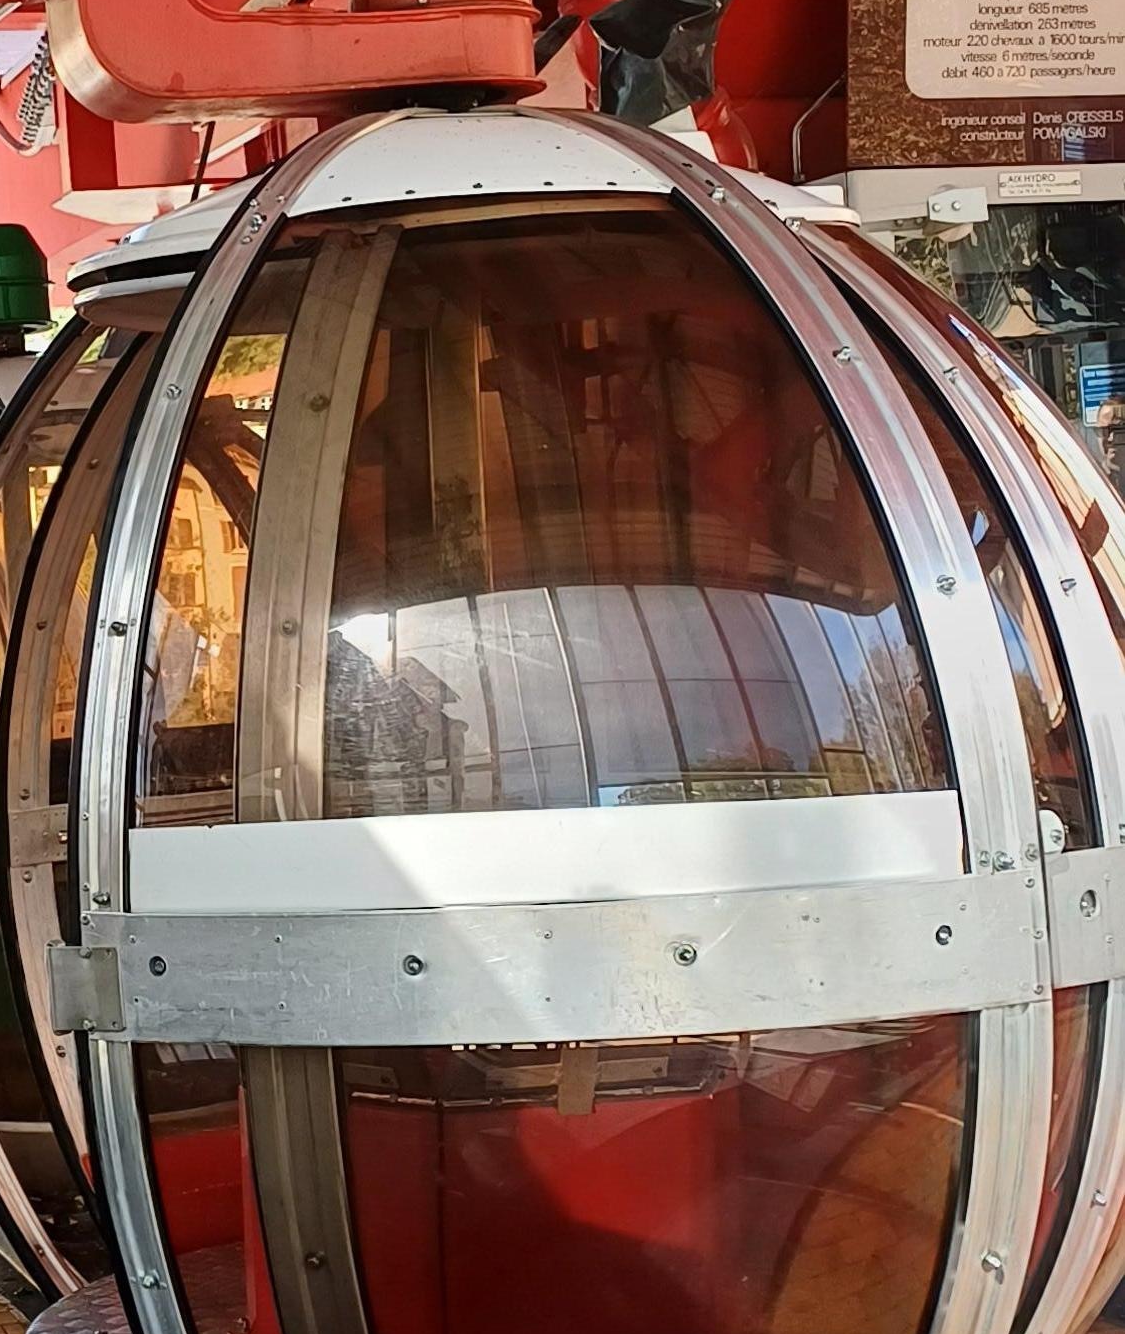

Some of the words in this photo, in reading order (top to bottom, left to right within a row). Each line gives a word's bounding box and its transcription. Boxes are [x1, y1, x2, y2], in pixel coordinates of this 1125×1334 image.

[978, 2, 1023, 17] longueur
[1028, 2, 1050, 15] 685
[1038, 17, 1059, 30] 263
[923, 36, 962, 47] moteur
[967, 34, 989, 47] 220
[991, 34, 1033, 46] chevaux
[1050, 33, 1076, 45] 1600
[961, 51, 997, 63] vitesse
[1002, 49, 1010, 62] 6
[971, 65, 995, 78] 460
[1005, 65, 1026, 78] 720
[1030, 64, 1116, 79] passagers/heure
[990, 112, 1026, 125] conseil
[1033, 111, 1063, 124] Denis
[1066, 110, 1124, 123] CREISSELS
[960, 128, 1025, 142] constructeur
[1033, 127, 1106, 140] POMAGALSKI
[1024, 173, 1055, 183] HYDRO
